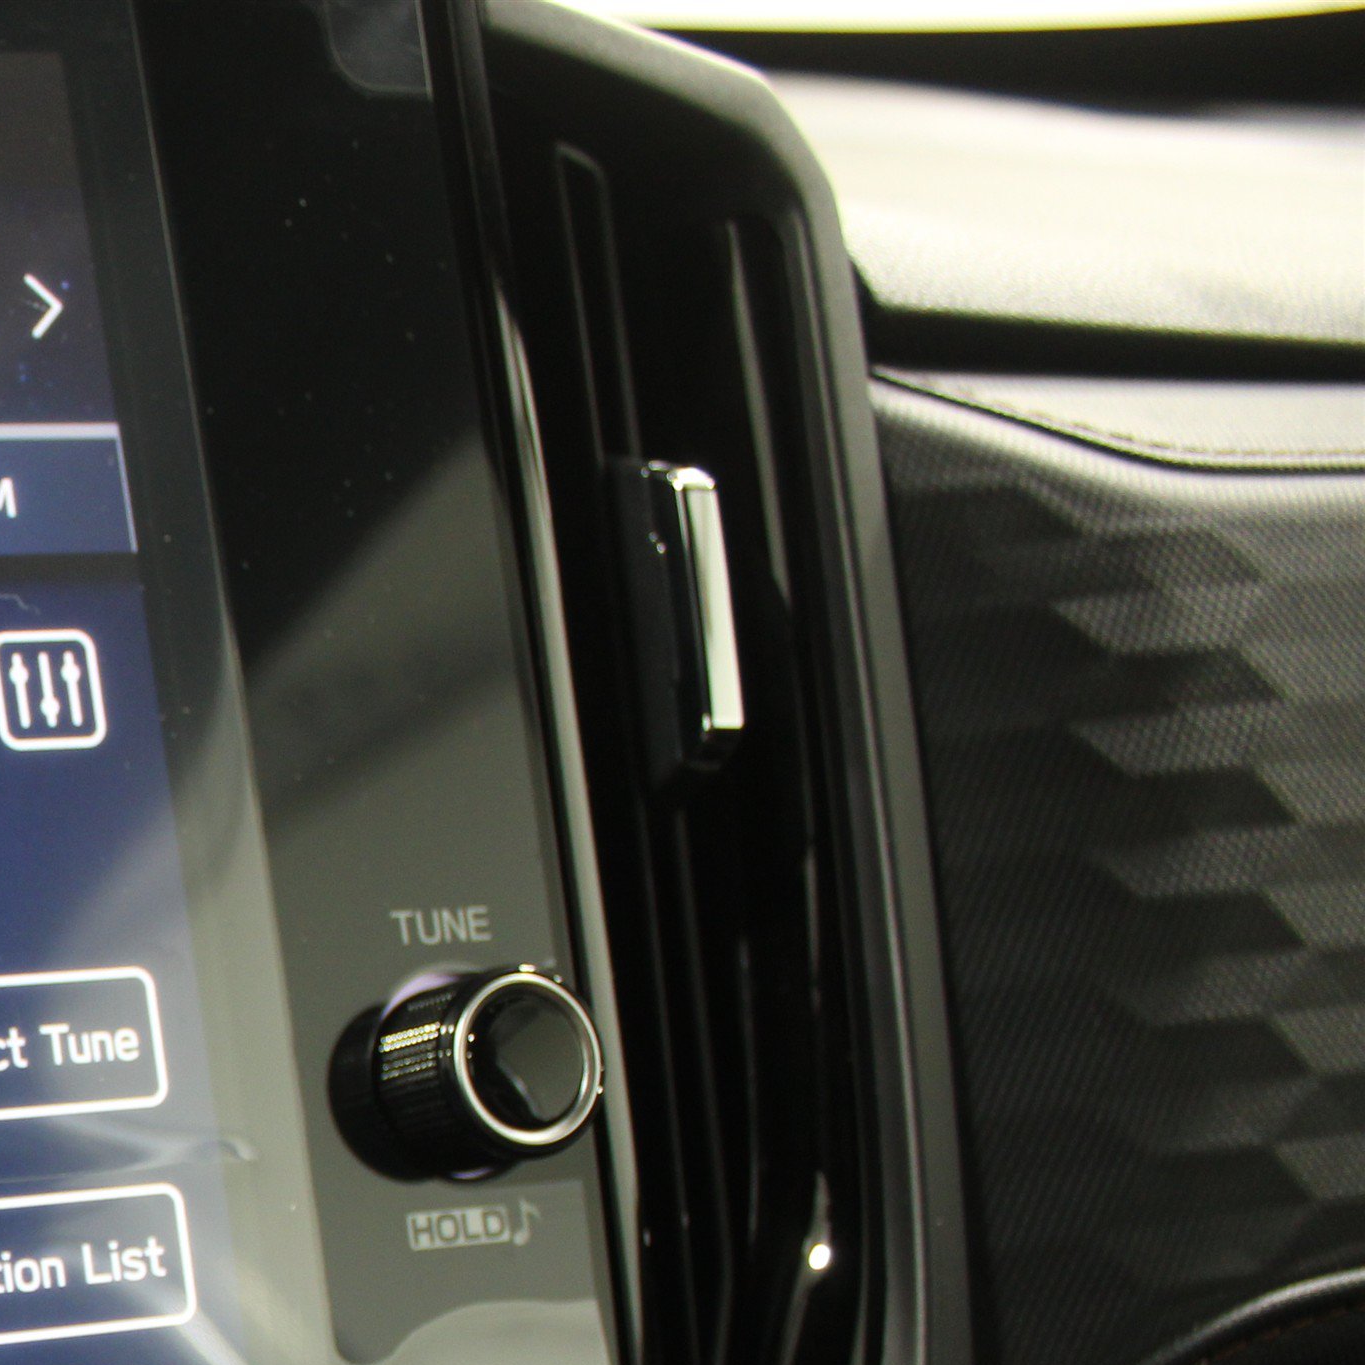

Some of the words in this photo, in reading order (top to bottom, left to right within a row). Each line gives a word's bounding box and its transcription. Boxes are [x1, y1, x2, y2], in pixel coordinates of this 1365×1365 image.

[389, 905, 492, 946] TUNE
[39, 1022, 141, 1066] Tune
[410, 1208, 506, 1246] HOLD
[81, 1236, 168, 1285] List
